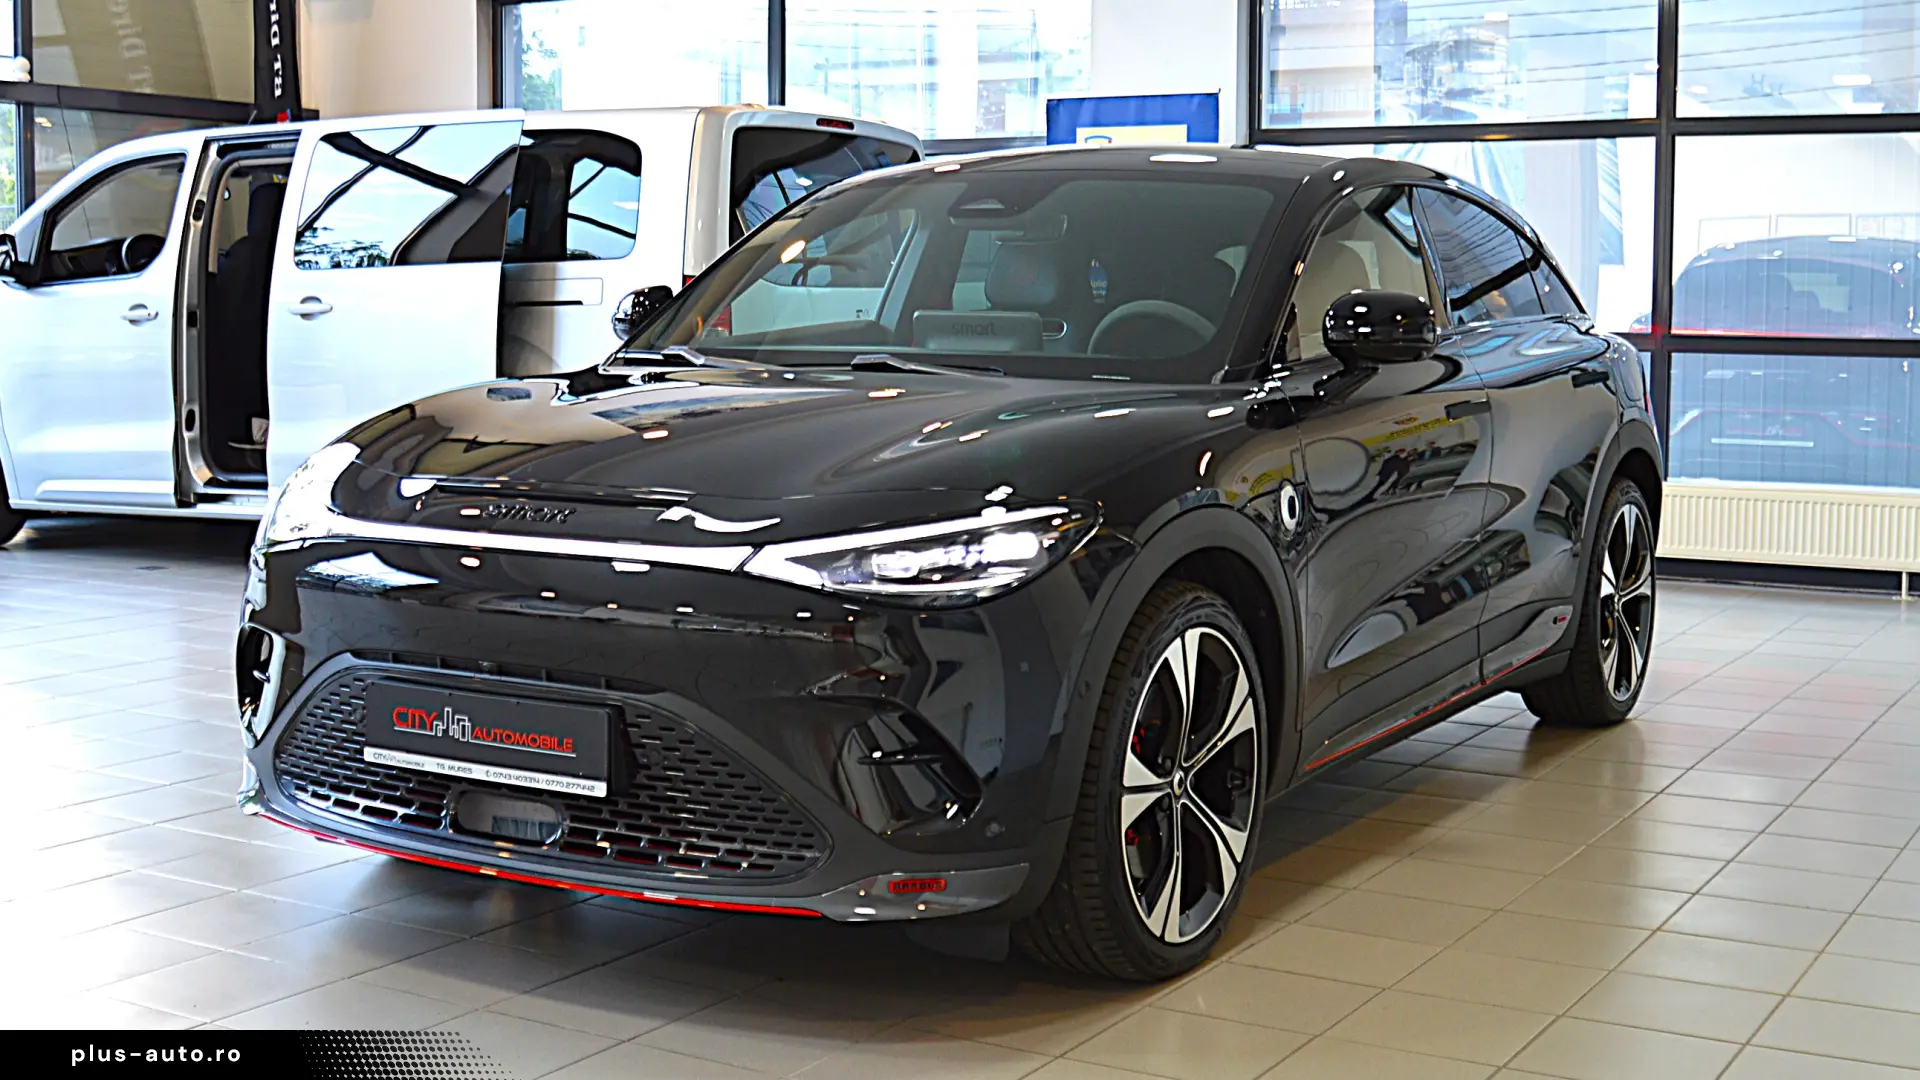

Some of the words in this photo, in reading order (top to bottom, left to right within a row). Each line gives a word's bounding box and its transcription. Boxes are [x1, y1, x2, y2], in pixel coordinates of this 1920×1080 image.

[952, 322, 998, 337] smart
[482, 504, 577, 524] smart
[392, 706, 438, 732] CITY
[471, 726, 574, 753] AUTOMOBILE
[436, 762, 446, 770] TG
[447, 765, 473, 775] MURES
[493, 771, 512, 781] 0743
[545, 779, 565, 788] 0770
